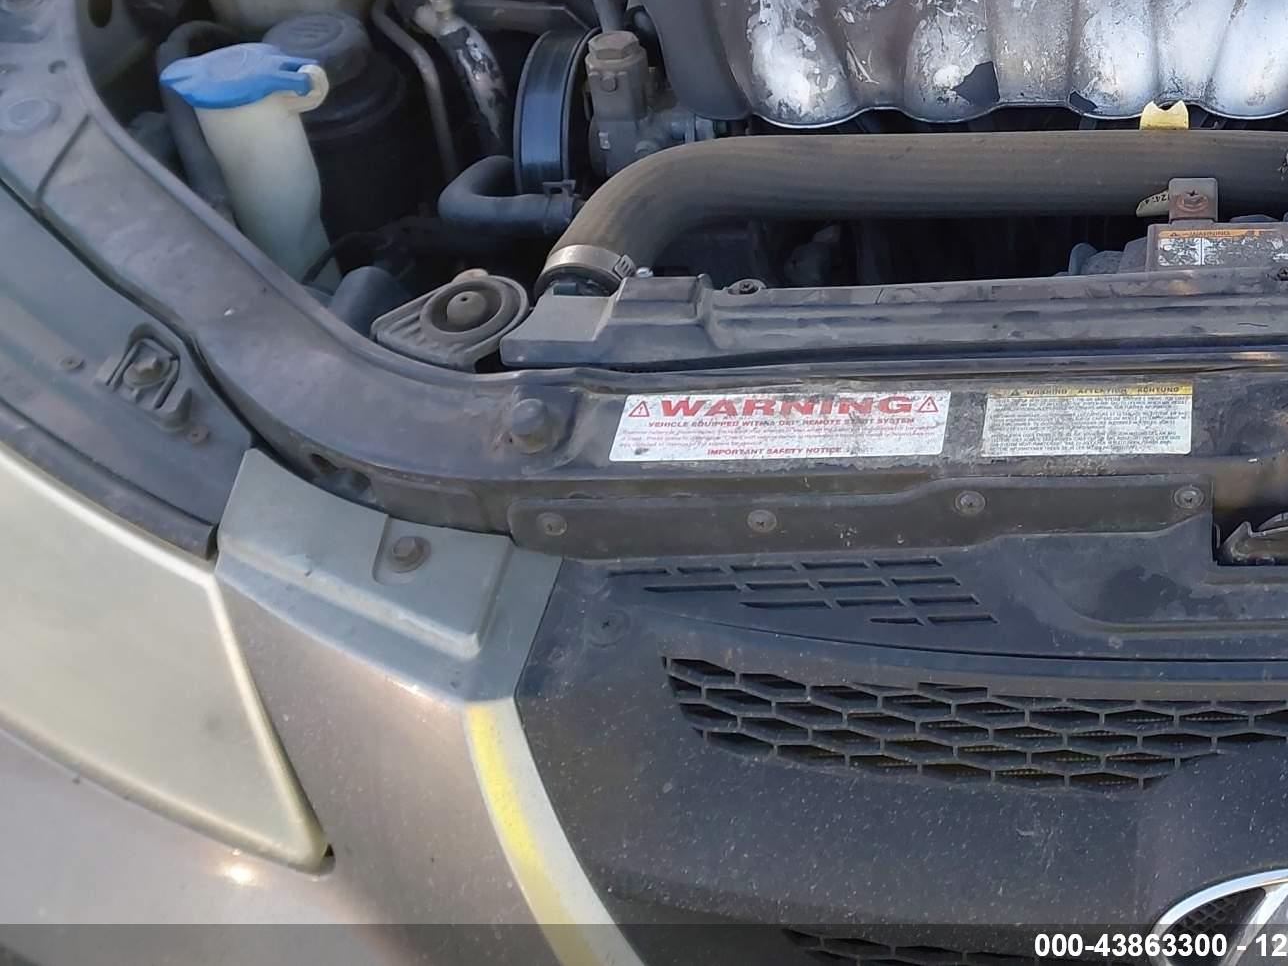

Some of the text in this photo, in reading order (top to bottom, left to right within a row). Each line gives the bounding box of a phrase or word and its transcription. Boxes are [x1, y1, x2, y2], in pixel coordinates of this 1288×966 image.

[661, 396, 913, 417] WARNING
[649, 420, 689, 428] VEHICLE
[802, 418, 841, 426] REMOTE
[876, 417, 915, 425] SYSTEM
[806, 446, 842, 454] NOTICE
